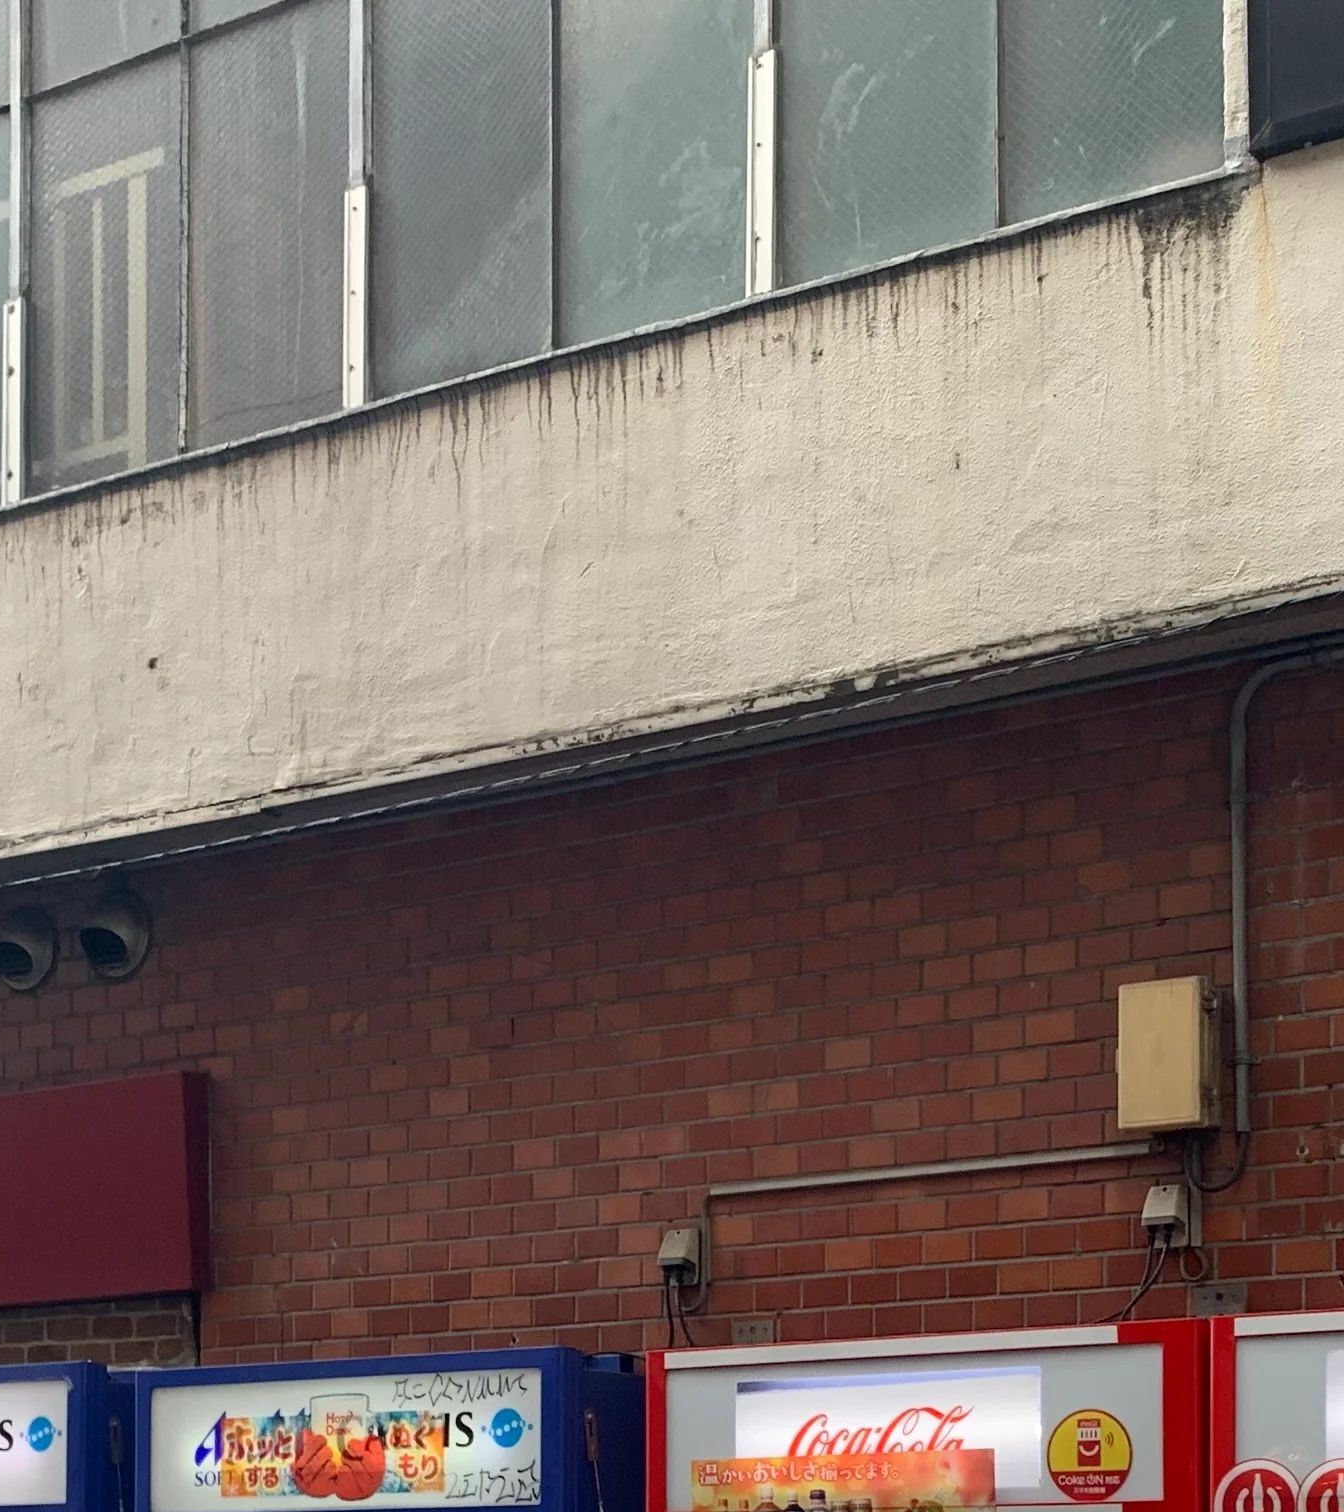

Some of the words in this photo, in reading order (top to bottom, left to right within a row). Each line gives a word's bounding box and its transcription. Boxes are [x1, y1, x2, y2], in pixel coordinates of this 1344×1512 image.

[244, 1465, 279, 1489] する
[398, 1455, 439, 1481] もり
[699, 1460, 904, 1487] 温かいおいしさ揃ってます。
[1058, 1475, 1086, 1486] Coke
